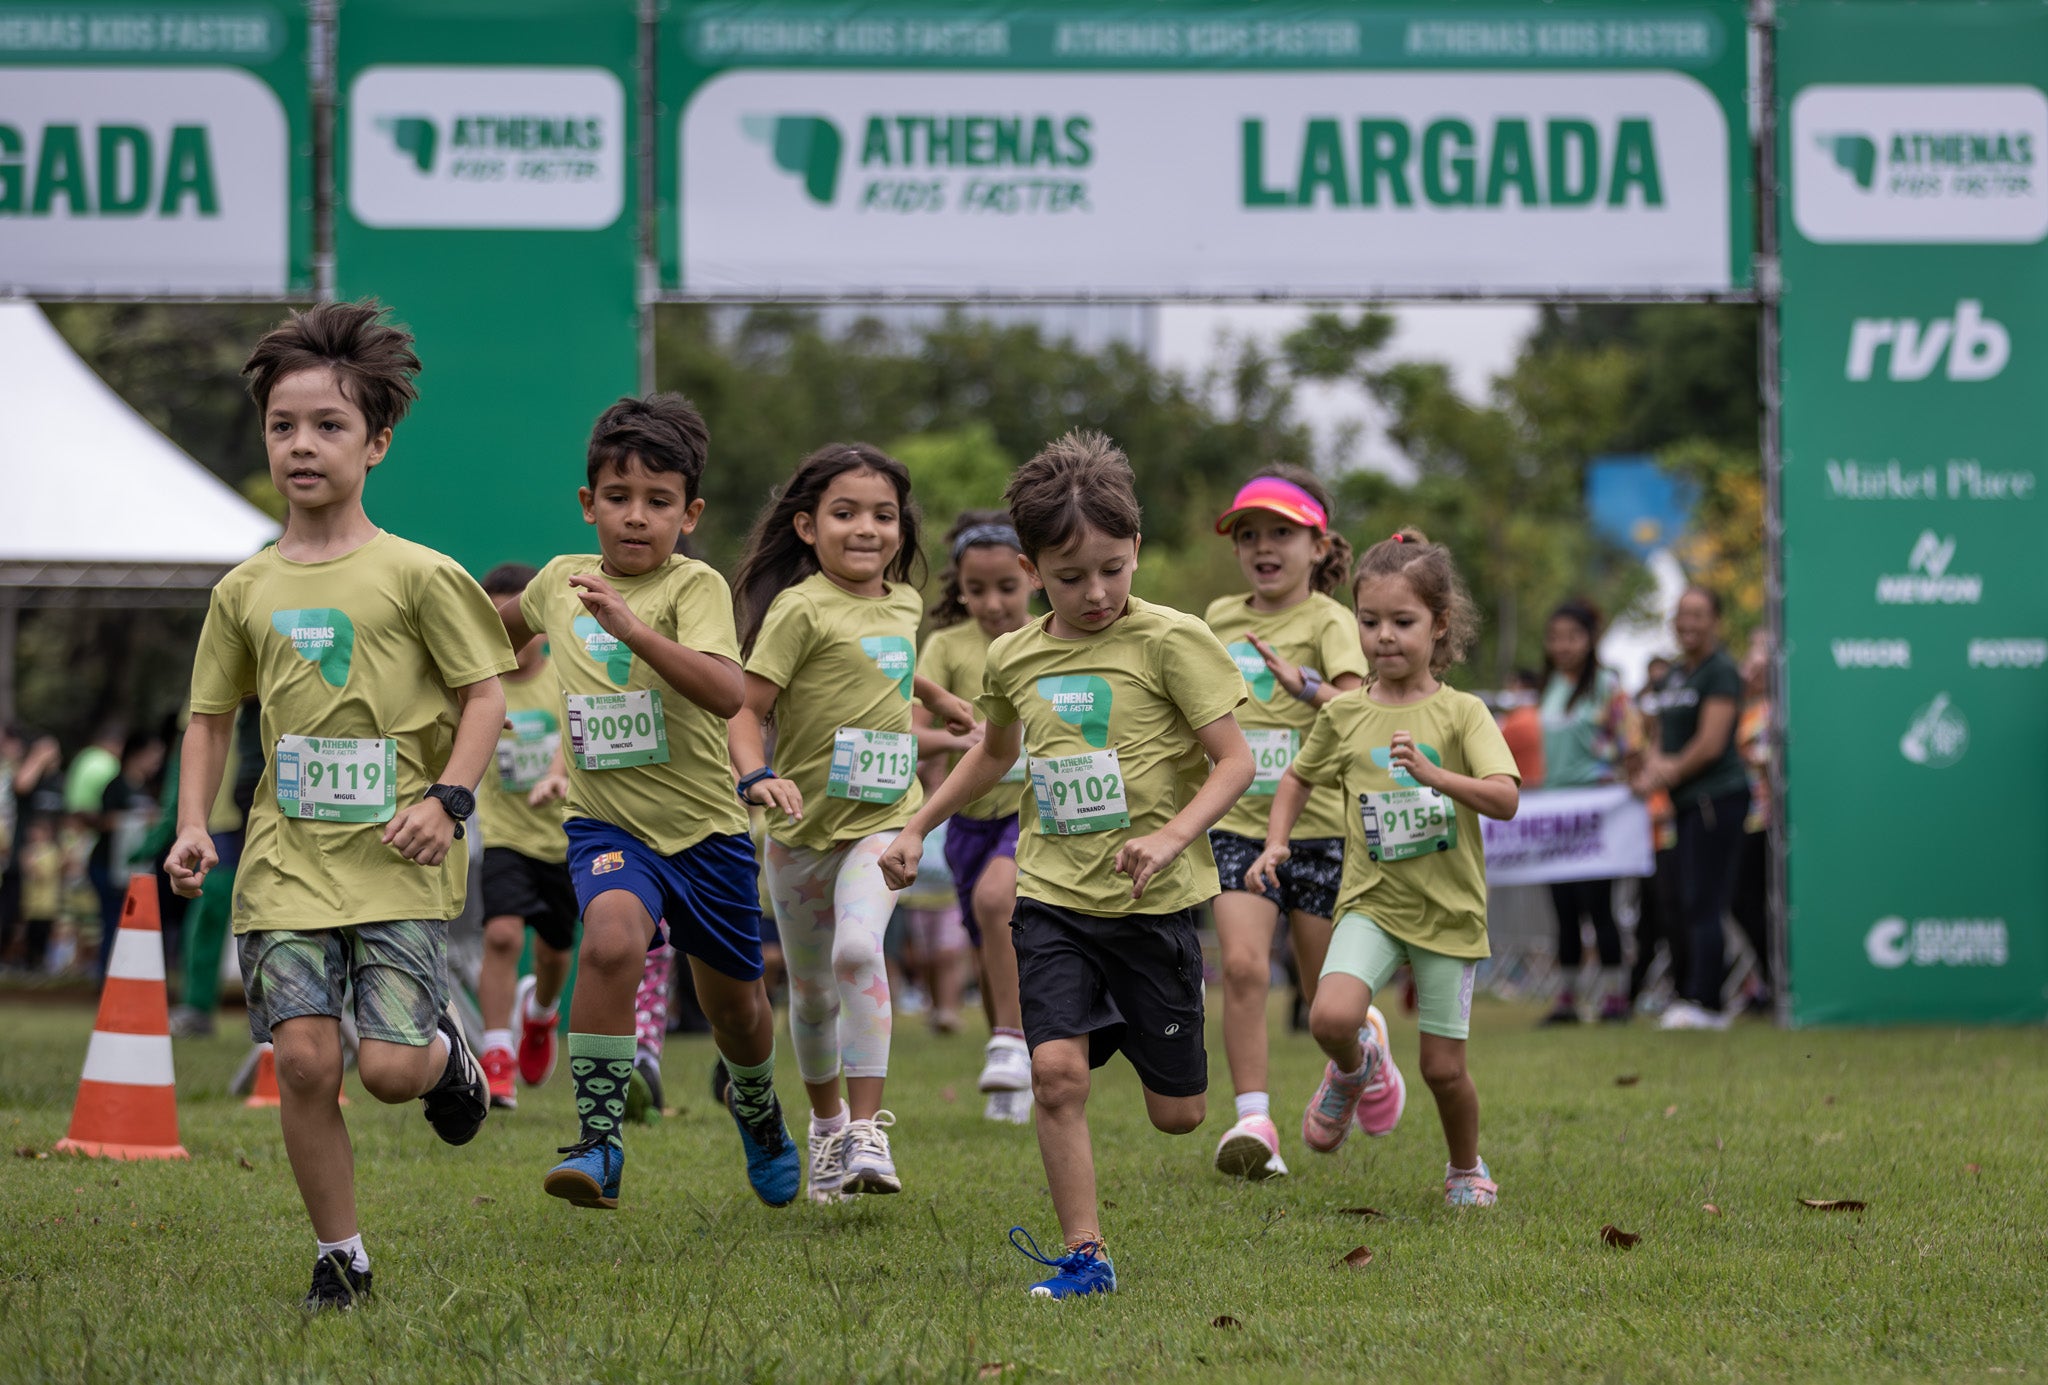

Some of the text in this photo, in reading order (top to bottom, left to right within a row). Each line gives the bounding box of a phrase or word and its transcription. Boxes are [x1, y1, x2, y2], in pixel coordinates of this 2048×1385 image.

[160, 19, 269, 52] FASTER
[449, 114, 604, 153] ATHENAS
[860, 115, 1095, 168] ATHENAS
[1240, 116, 1665, 210] LARGADA
[1888, 132, 2034, 168] ATHENAS
[515, 156, 602, 182] FASTER
[858, 178, 1094, 213] KIDS FASTER
[1844, 298, 2012, 383] rvb
[1825, 458, 2036, 501] Market Place
[290, 627, 335, 640] ATHENAS
[291, 640, 334, 648] KIDS FASTER
[1052, 692, 1095, 704] ATHENAS
[1069, 704, 1094, 712] FASTER
[587, 712, 652, 741] 9090
[278, 753, 299, 761] 100m
[321, 740, 358, 750] ATHENAS
[610, 741, 634, 750] VINICIUS
[307, 760, 382, 790] 9119
[860, 750, 910, 777] 9113
[1060, 756, 1094, 769] ATHENAS
[278, 788, 300, 800] 2018
[1052, 773, 1122, 807] 9102
[1077, 804, 1106, 815] FERNANDO
[1383, 805, 1443, 833] 9155
